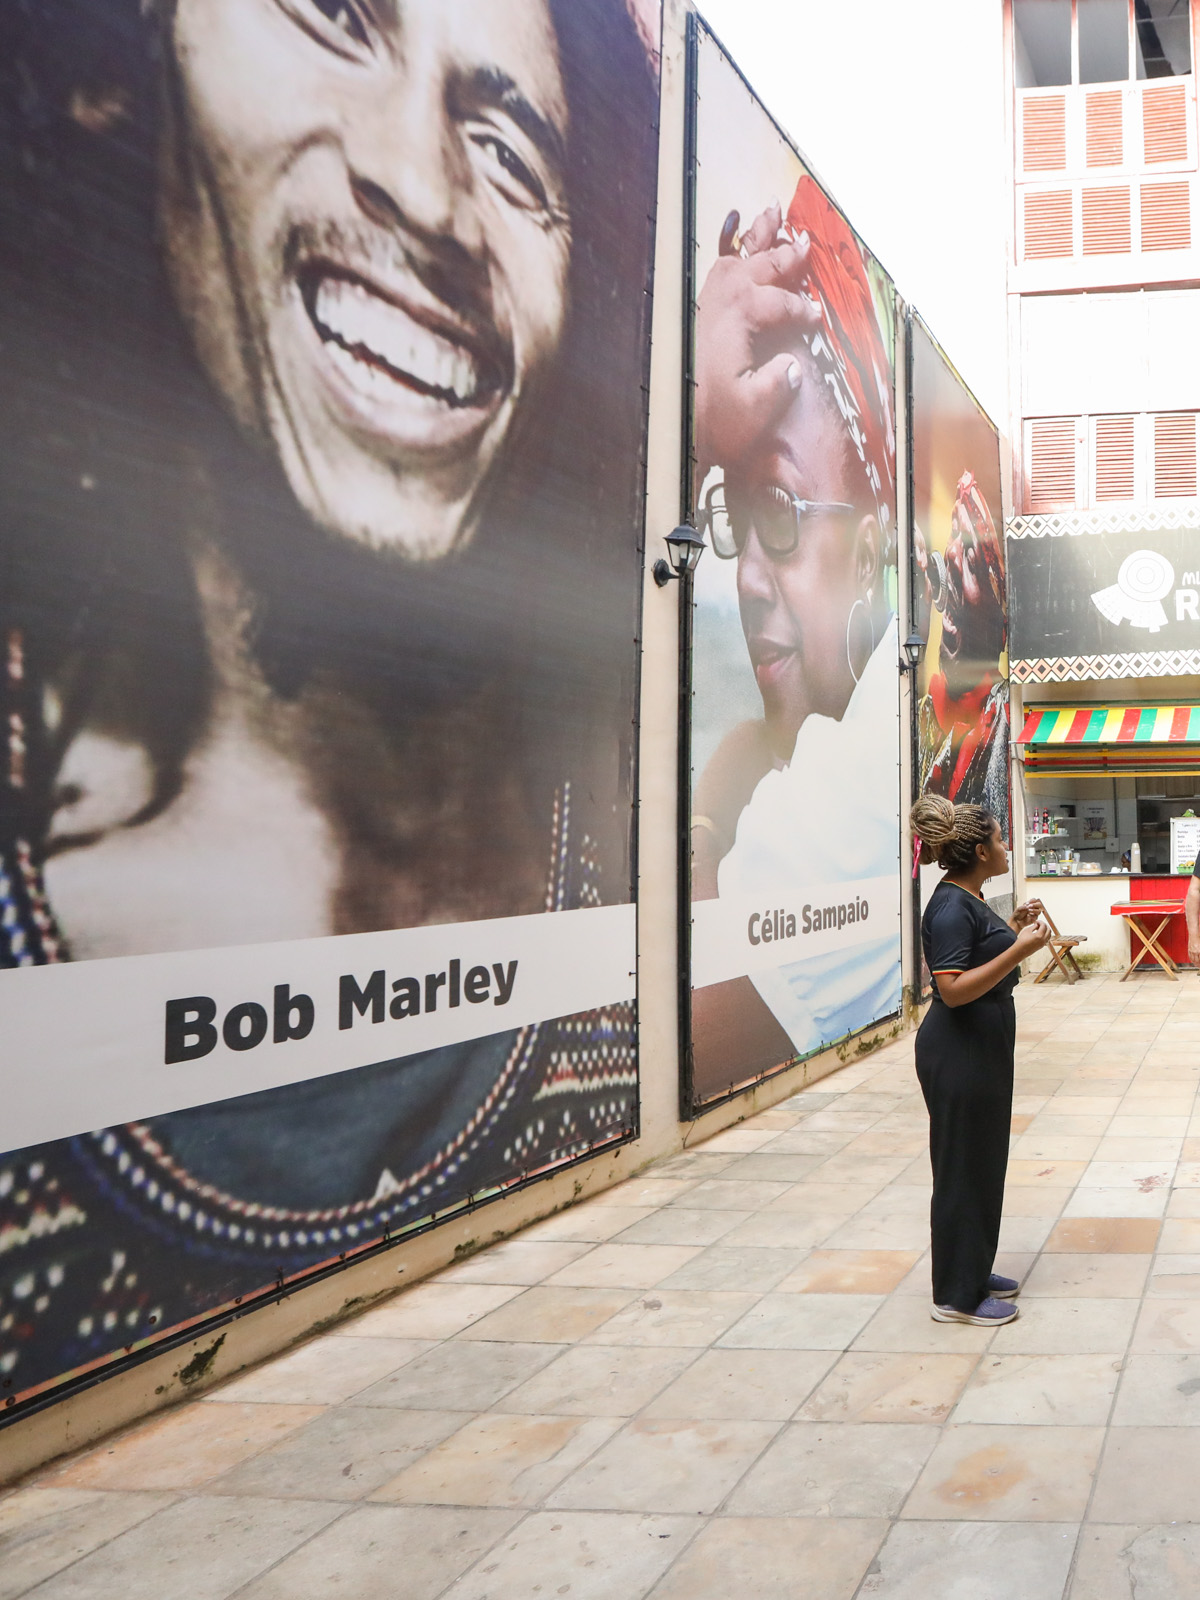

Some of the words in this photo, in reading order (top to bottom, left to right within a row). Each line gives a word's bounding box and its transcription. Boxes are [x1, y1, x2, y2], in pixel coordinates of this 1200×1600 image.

[747, 908, 797, 946] Célia
[801, 895, 869, 935] Sampaio
[164, 983, 315, 1065] Bob
[338, 958, 519, 1031] Marley
